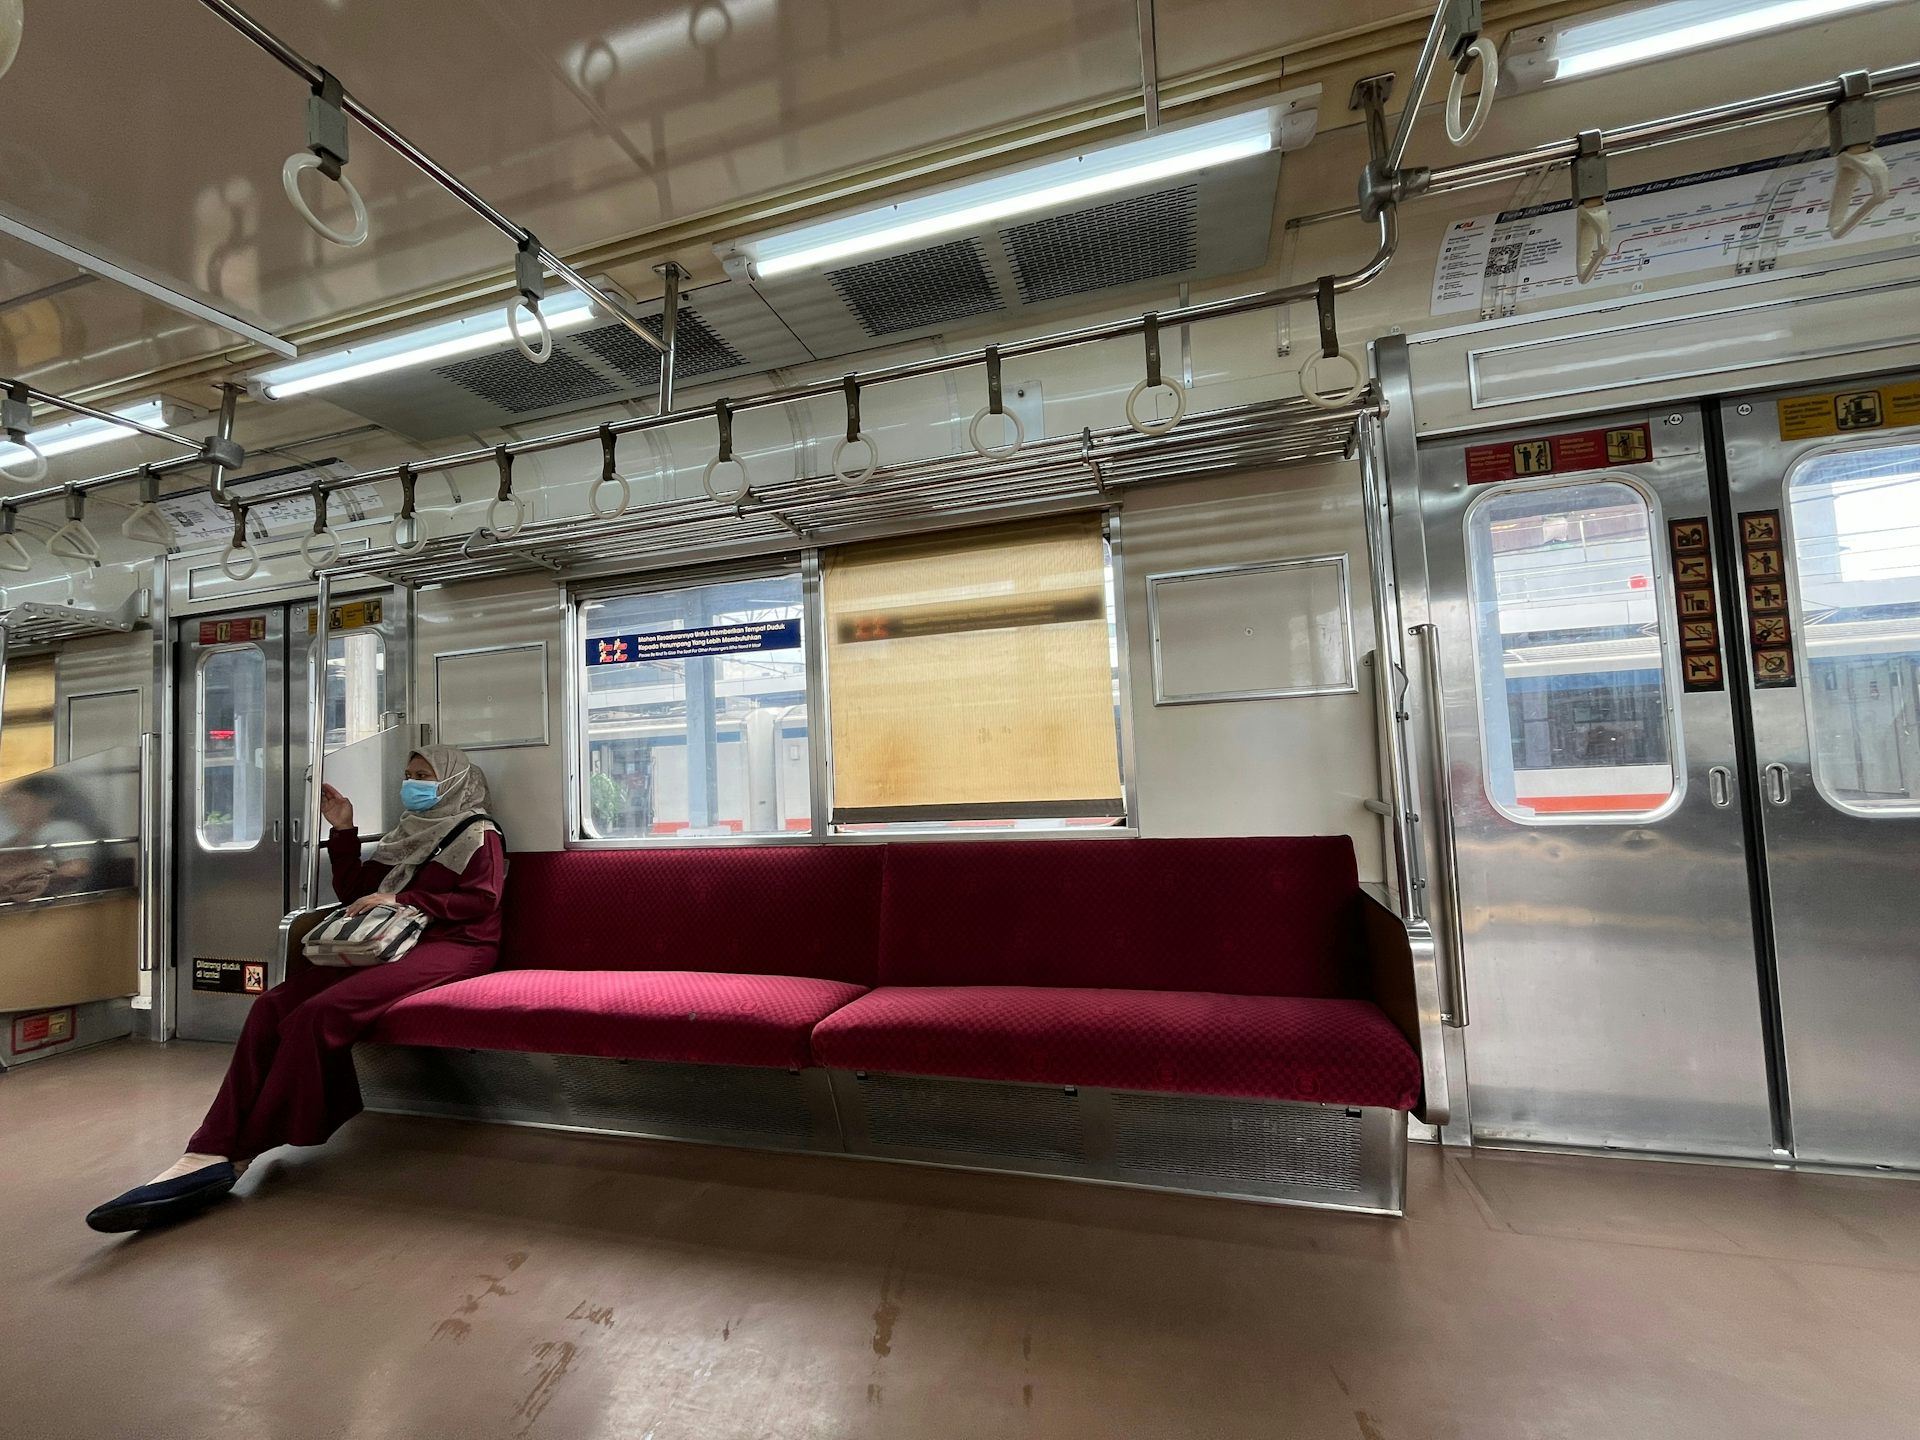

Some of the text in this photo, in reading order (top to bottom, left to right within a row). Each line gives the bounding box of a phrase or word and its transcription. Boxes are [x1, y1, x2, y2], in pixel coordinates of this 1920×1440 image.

[1605, 187, 1646, 199] mmuter
[1646, 182, 1669, 191] Line
[694, 630, 709, 638] Untuk
[710, 627, 744, 636] Memberikan
[745, 624, 766, 633] Tempat
[722, 635, 761, 643] Membutuhkan
[196, 960, 241, 971] Dilarang duduk
